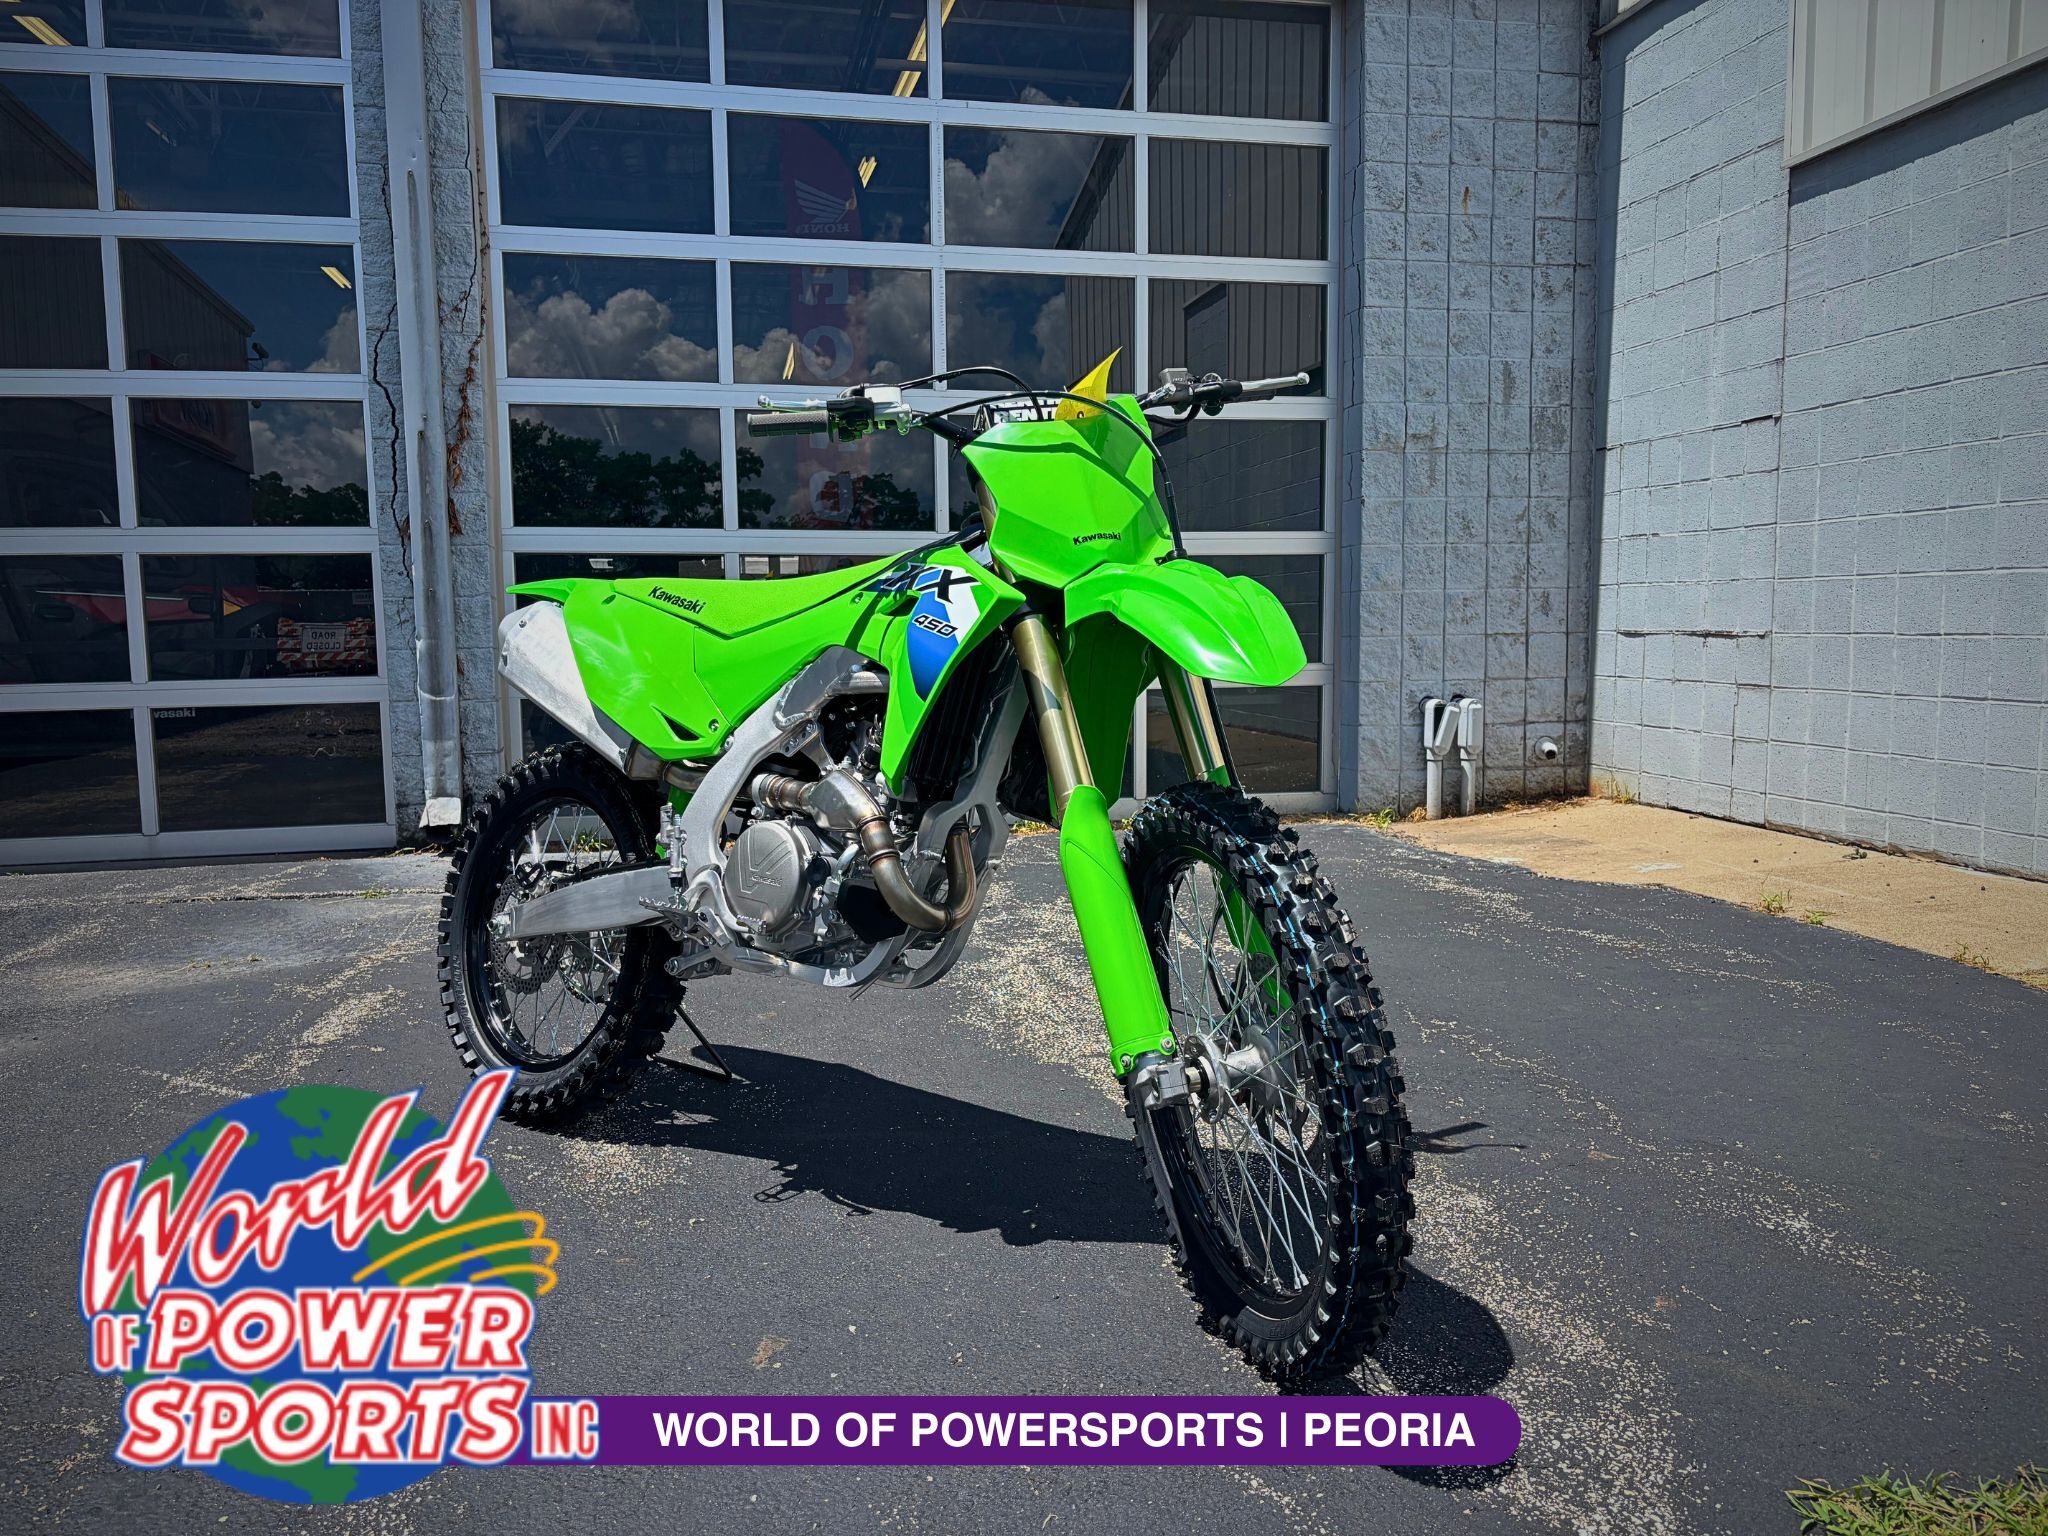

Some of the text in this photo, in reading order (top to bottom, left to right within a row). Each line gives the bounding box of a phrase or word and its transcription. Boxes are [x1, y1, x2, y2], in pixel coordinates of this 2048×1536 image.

[1072, 532, 1121, 545] Kawasaki
[648, 586, 706, 614] Kawasaki
[912, 613, 958, 638] 450
